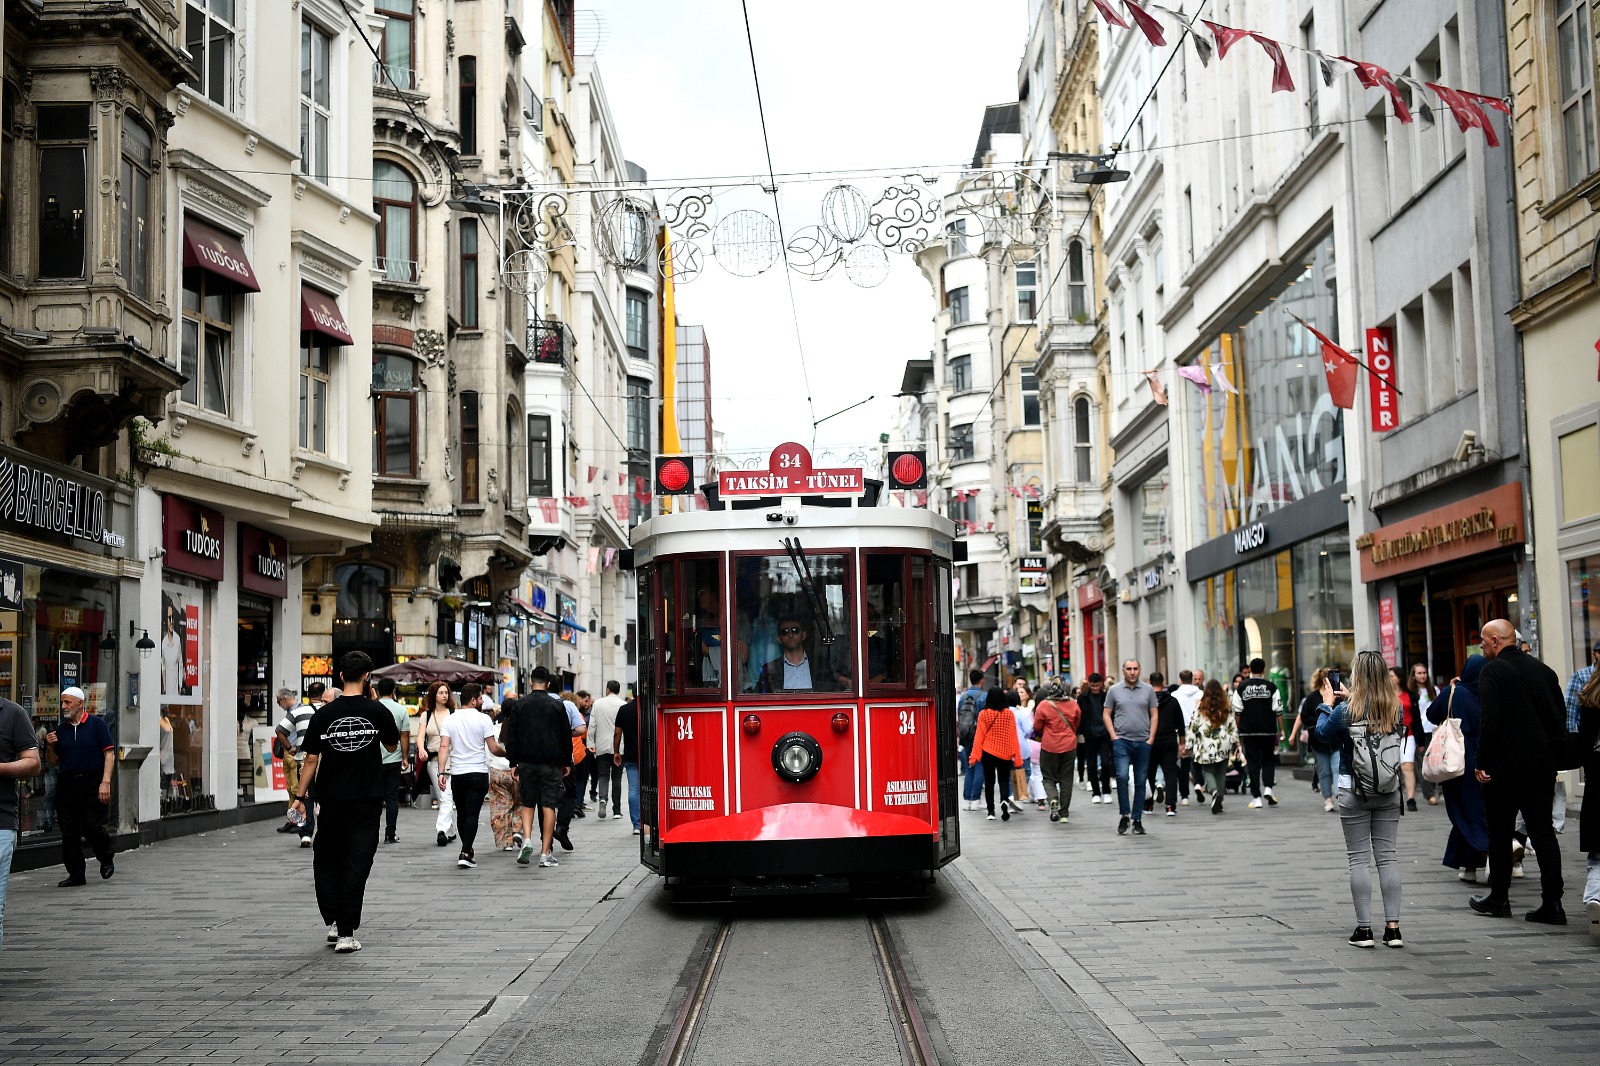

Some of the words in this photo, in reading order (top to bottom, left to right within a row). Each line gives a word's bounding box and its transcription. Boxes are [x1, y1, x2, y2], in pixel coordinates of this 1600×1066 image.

[198, 244, 249, 278] TUDORS
[309, 308, 349, 336] TUDORS
[1372, 336, 1393, 427] NOTER
[779, 453, 802, 468] 34
[726, 472, 789, 490] TAKSİM
[806, 472, 858, 489] TÜNEL
[15, 464, 104, 542] BARGELLO
[102, 528, 125, 548] Perfume
[186, 529, 220, 560] TUDORS
[1234, 522, 1265, 554] MANGO
[258, 554, 285, 580] TUDORS
[1024, 559, 1042, 568] FAL
[187, 618, 198, 629] NEW
[677, 715, 694, 740] 34
[899, 710, 916, 735] 34
[669, 786, 690, 798] ASILMAK
[690, 786, 712, 798] YASAK
[886, 781, 913, 793] ASILMAK
[912, 779, 927, 791] YASAK
[884, 794, 894, 806] VE
